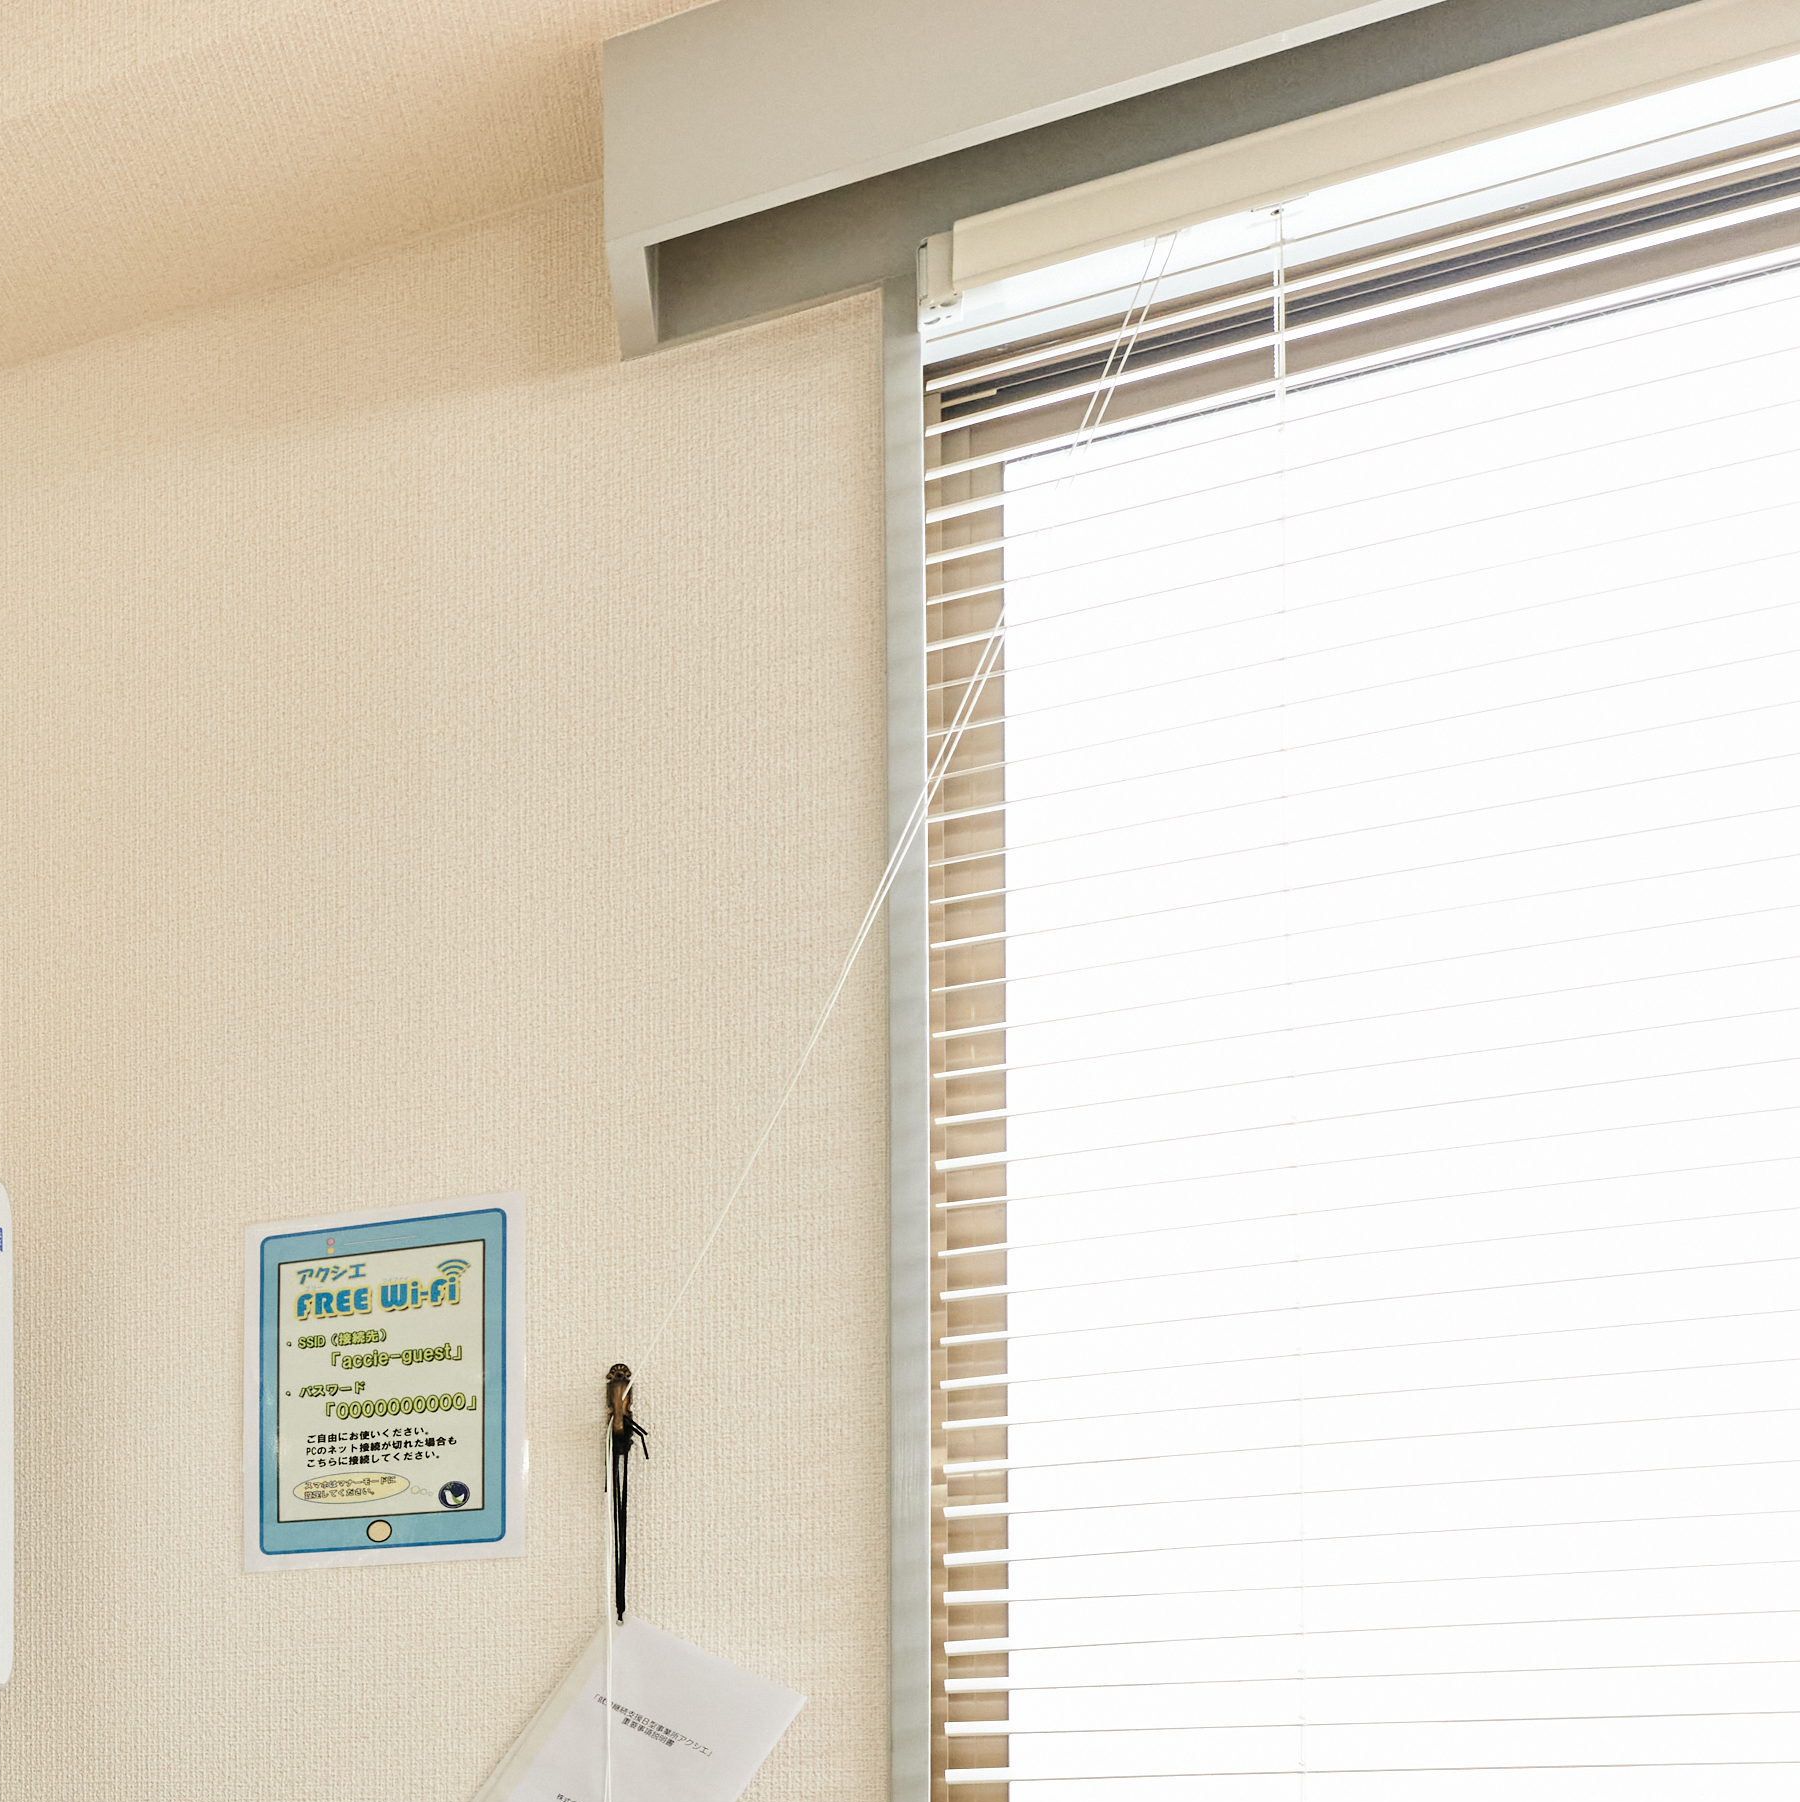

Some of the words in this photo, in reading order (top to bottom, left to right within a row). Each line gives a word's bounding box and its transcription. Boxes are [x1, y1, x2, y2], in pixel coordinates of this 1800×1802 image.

[296, 1262, 366, 1285] アクシエ
[295, 1286, 372, 1320] FREE
[299, 1381, 366, 1398] パスワード
[306, 1426, 429, 1444] ご自由にお使いください。
[306, 1436, 458, 1456] PCのネット接続が切れた場合も
[306, 1451, 440, 1468] こちらに接続してください。
